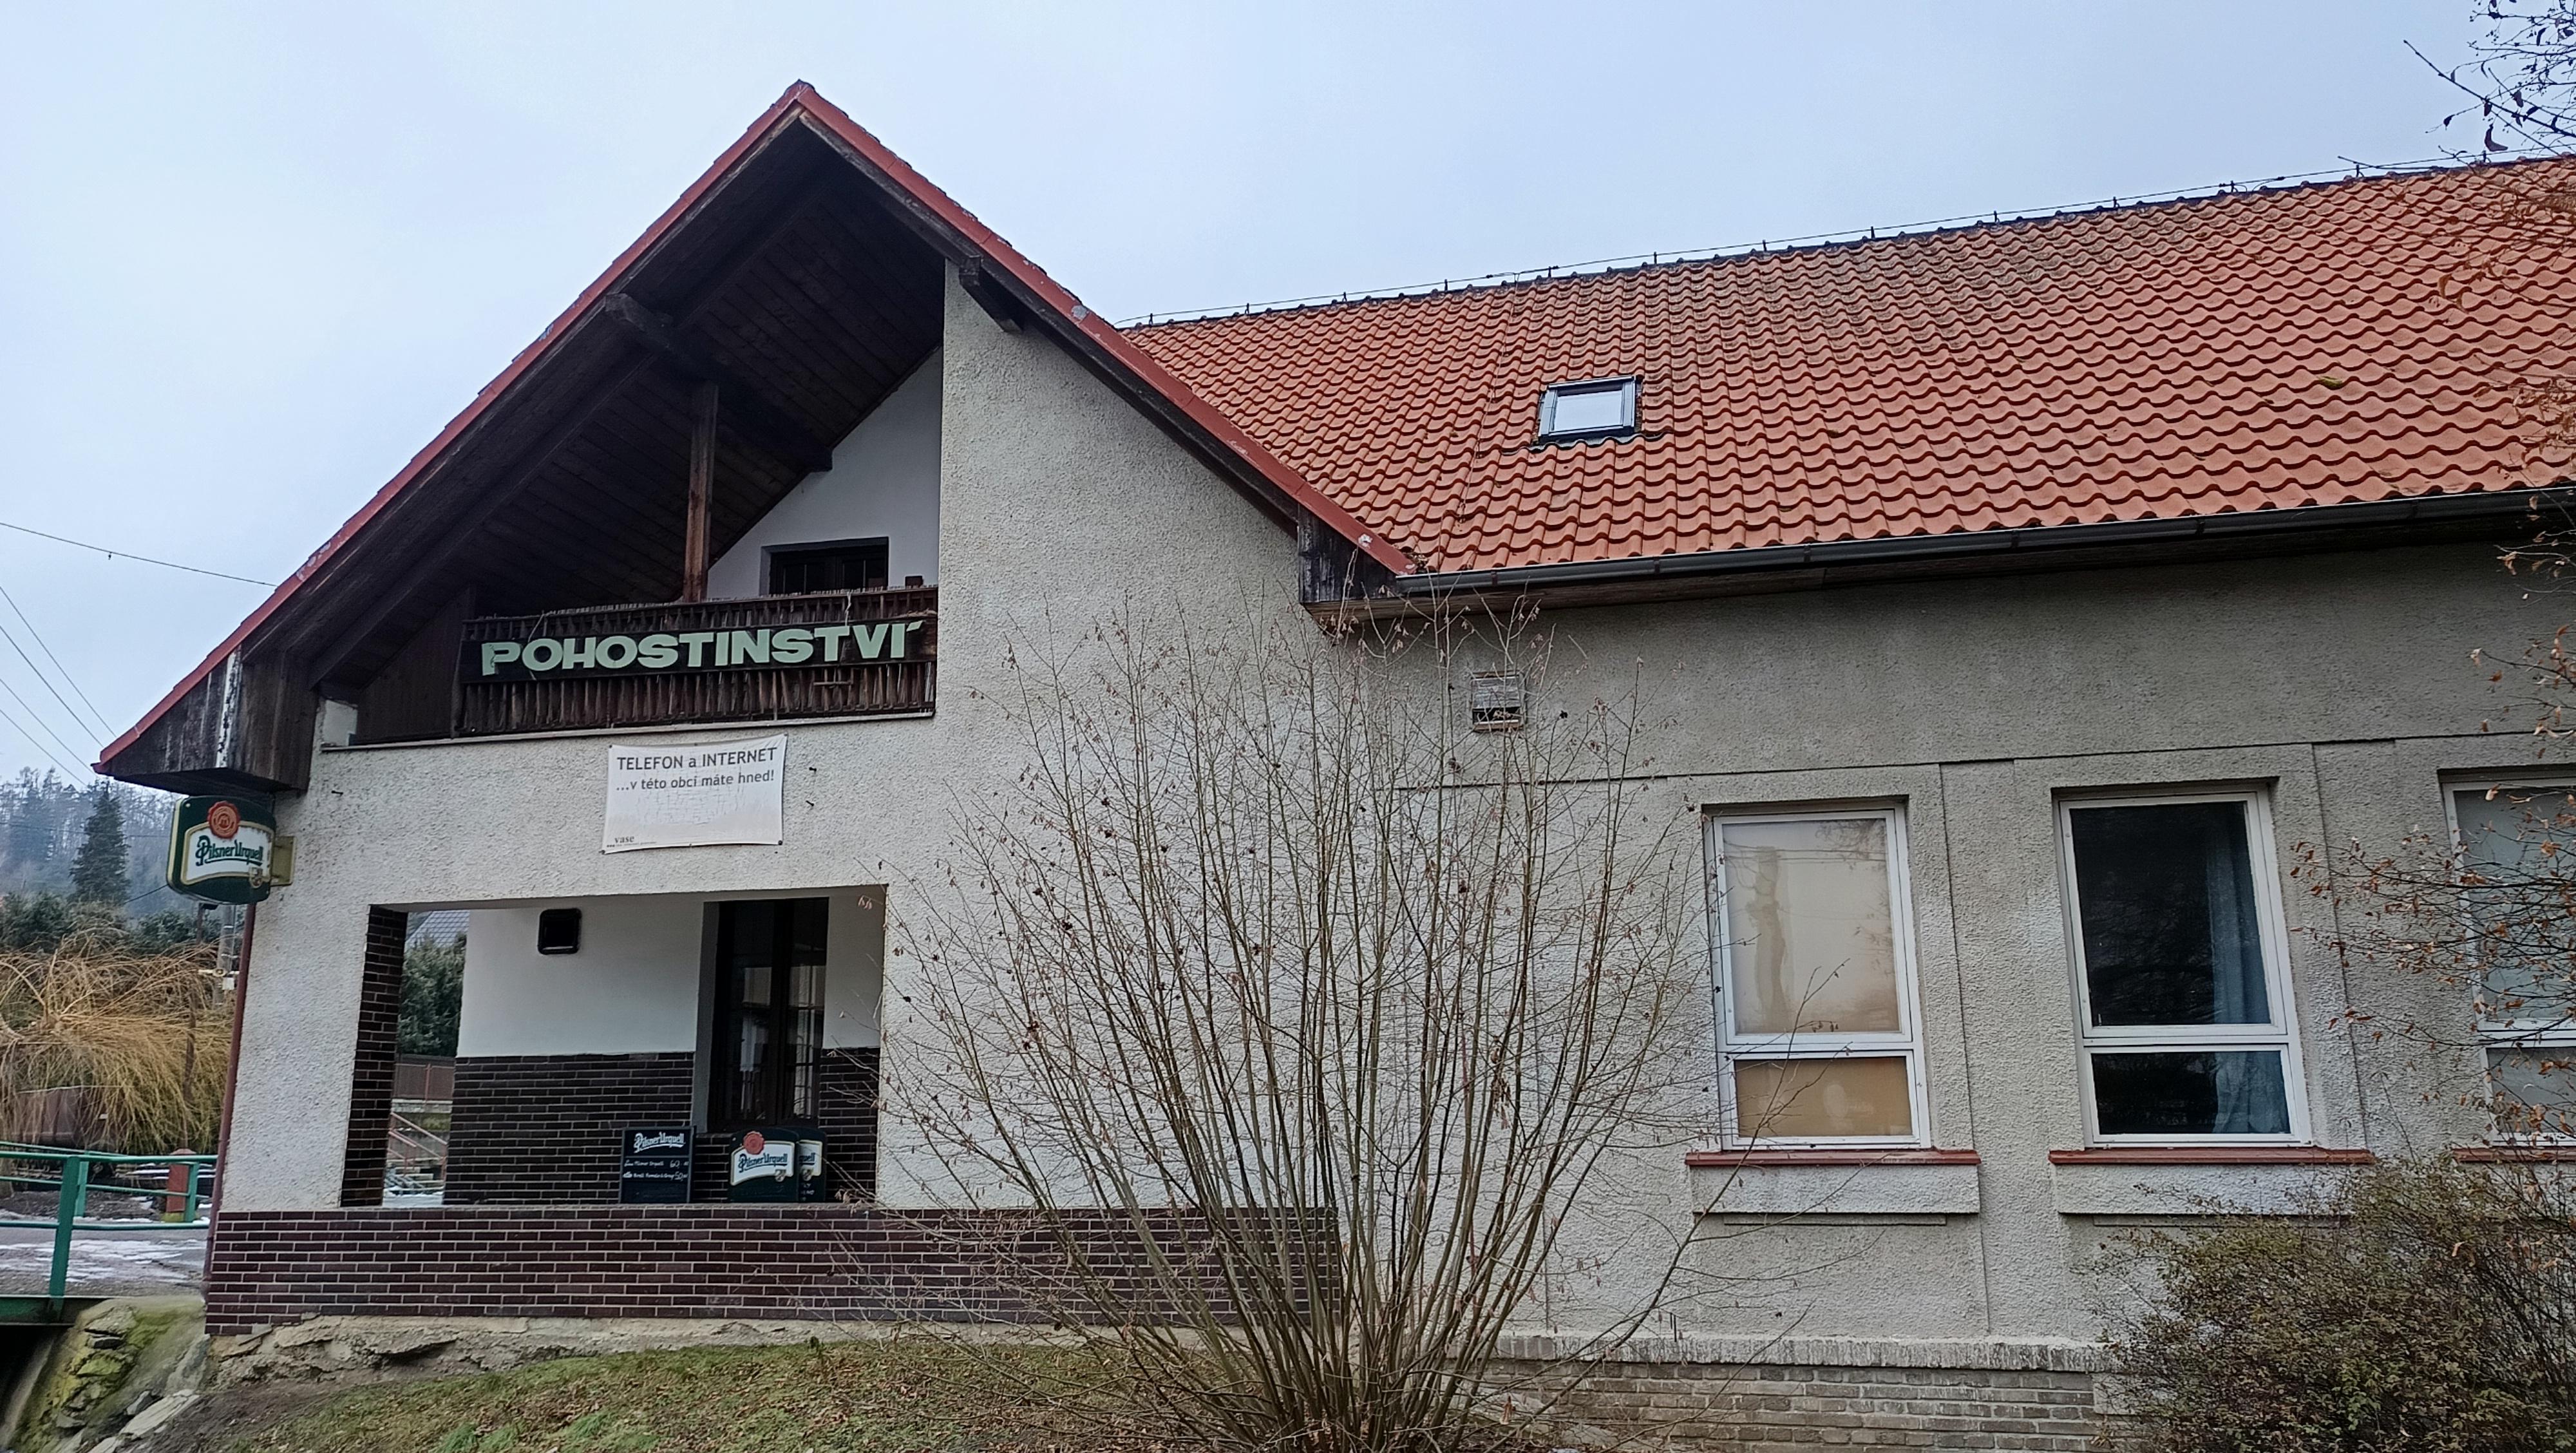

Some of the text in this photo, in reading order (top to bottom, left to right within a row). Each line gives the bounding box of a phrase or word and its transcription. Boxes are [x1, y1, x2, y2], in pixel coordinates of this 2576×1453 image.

[481, 620, 924, 676] POHOSTINSTVÍ
[617, 748, 777, 770] TELEFON a INTERNET
[641, 777, 667, 790] této
[671, 775, 697, 788] obci
[701, 774, 734, 786] máte
[738, 770, 774, 784] hned!
[195, 835, 264, 866] Pilsner Urquell
[633, 1132, 686, 1153] Pilsner Urquell
[738, 1153, 788, 1173] Pilsner Urquell
